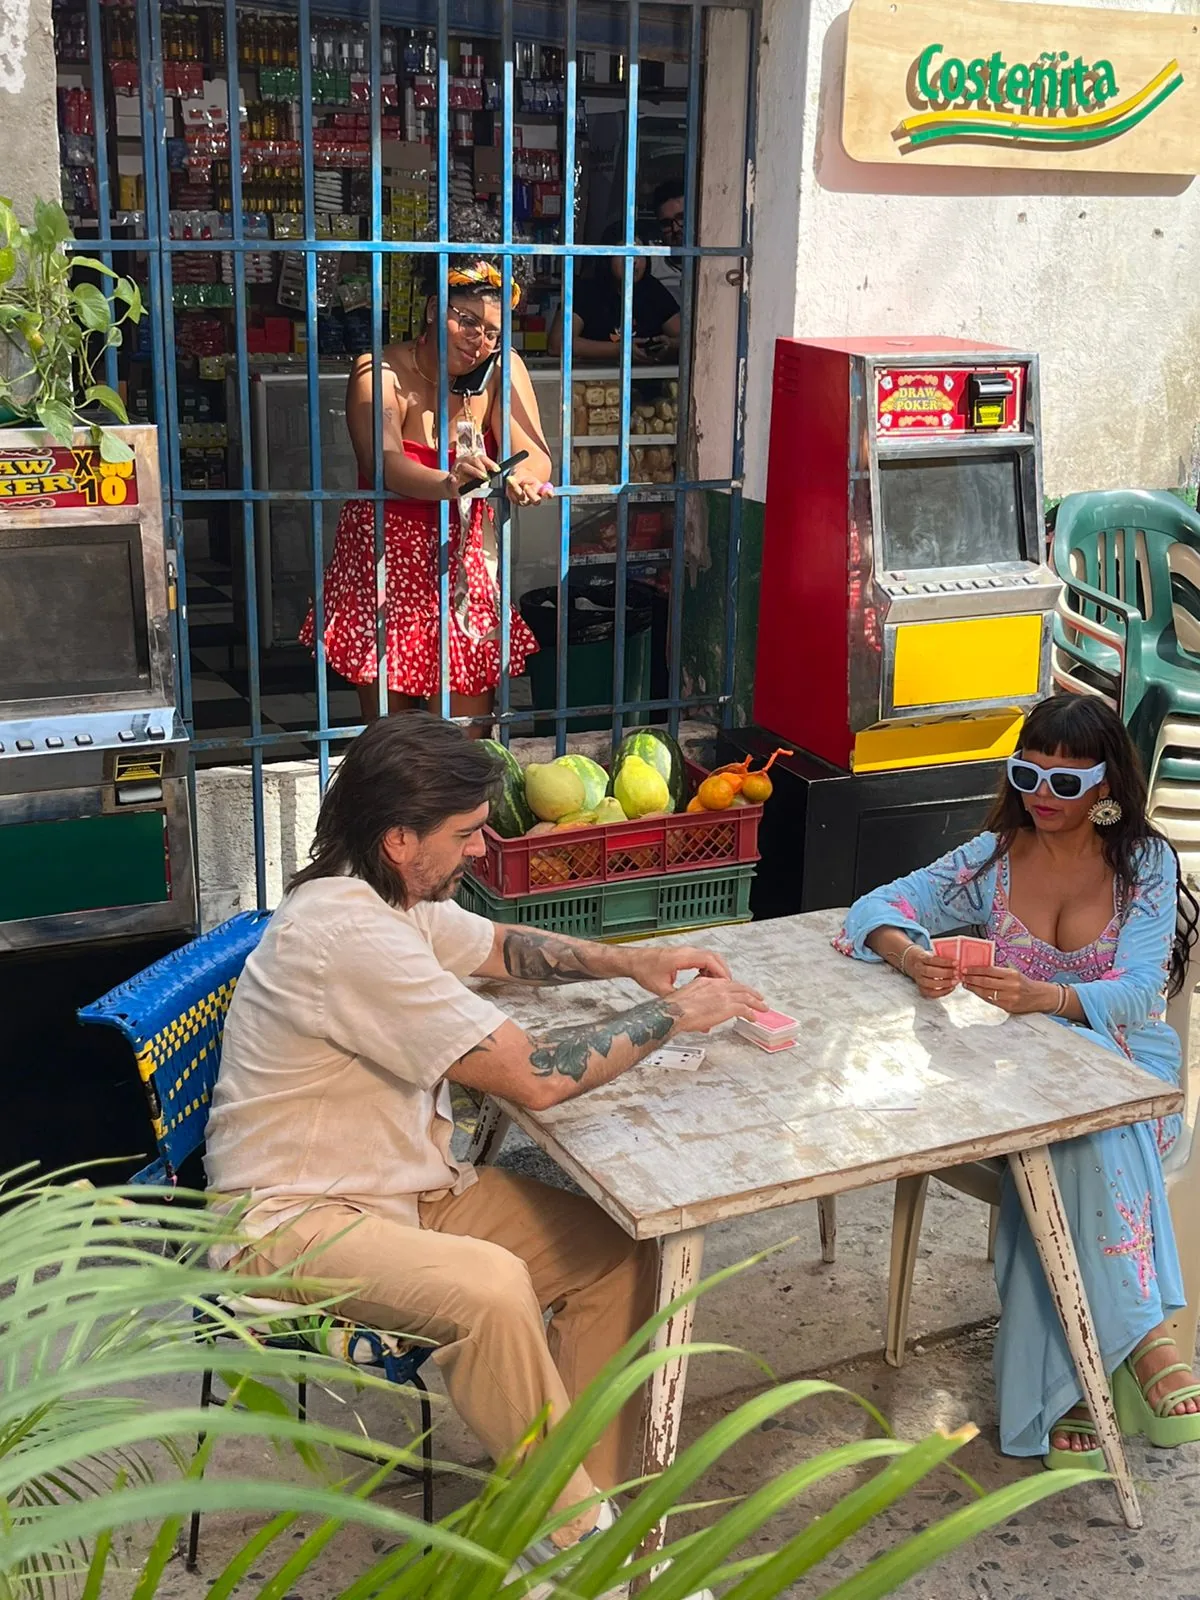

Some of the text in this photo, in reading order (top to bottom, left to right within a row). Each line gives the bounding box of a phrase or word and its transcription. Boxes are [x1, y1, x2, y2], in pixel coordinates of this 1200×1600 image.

[917, 43, 1119, 111] Costeñita
[896, 399, 939, 411] POKER
[898, 387, 936, 398] DRAW
[71, 450, 95, 478] X
[79, 475, 127, 505] 10
